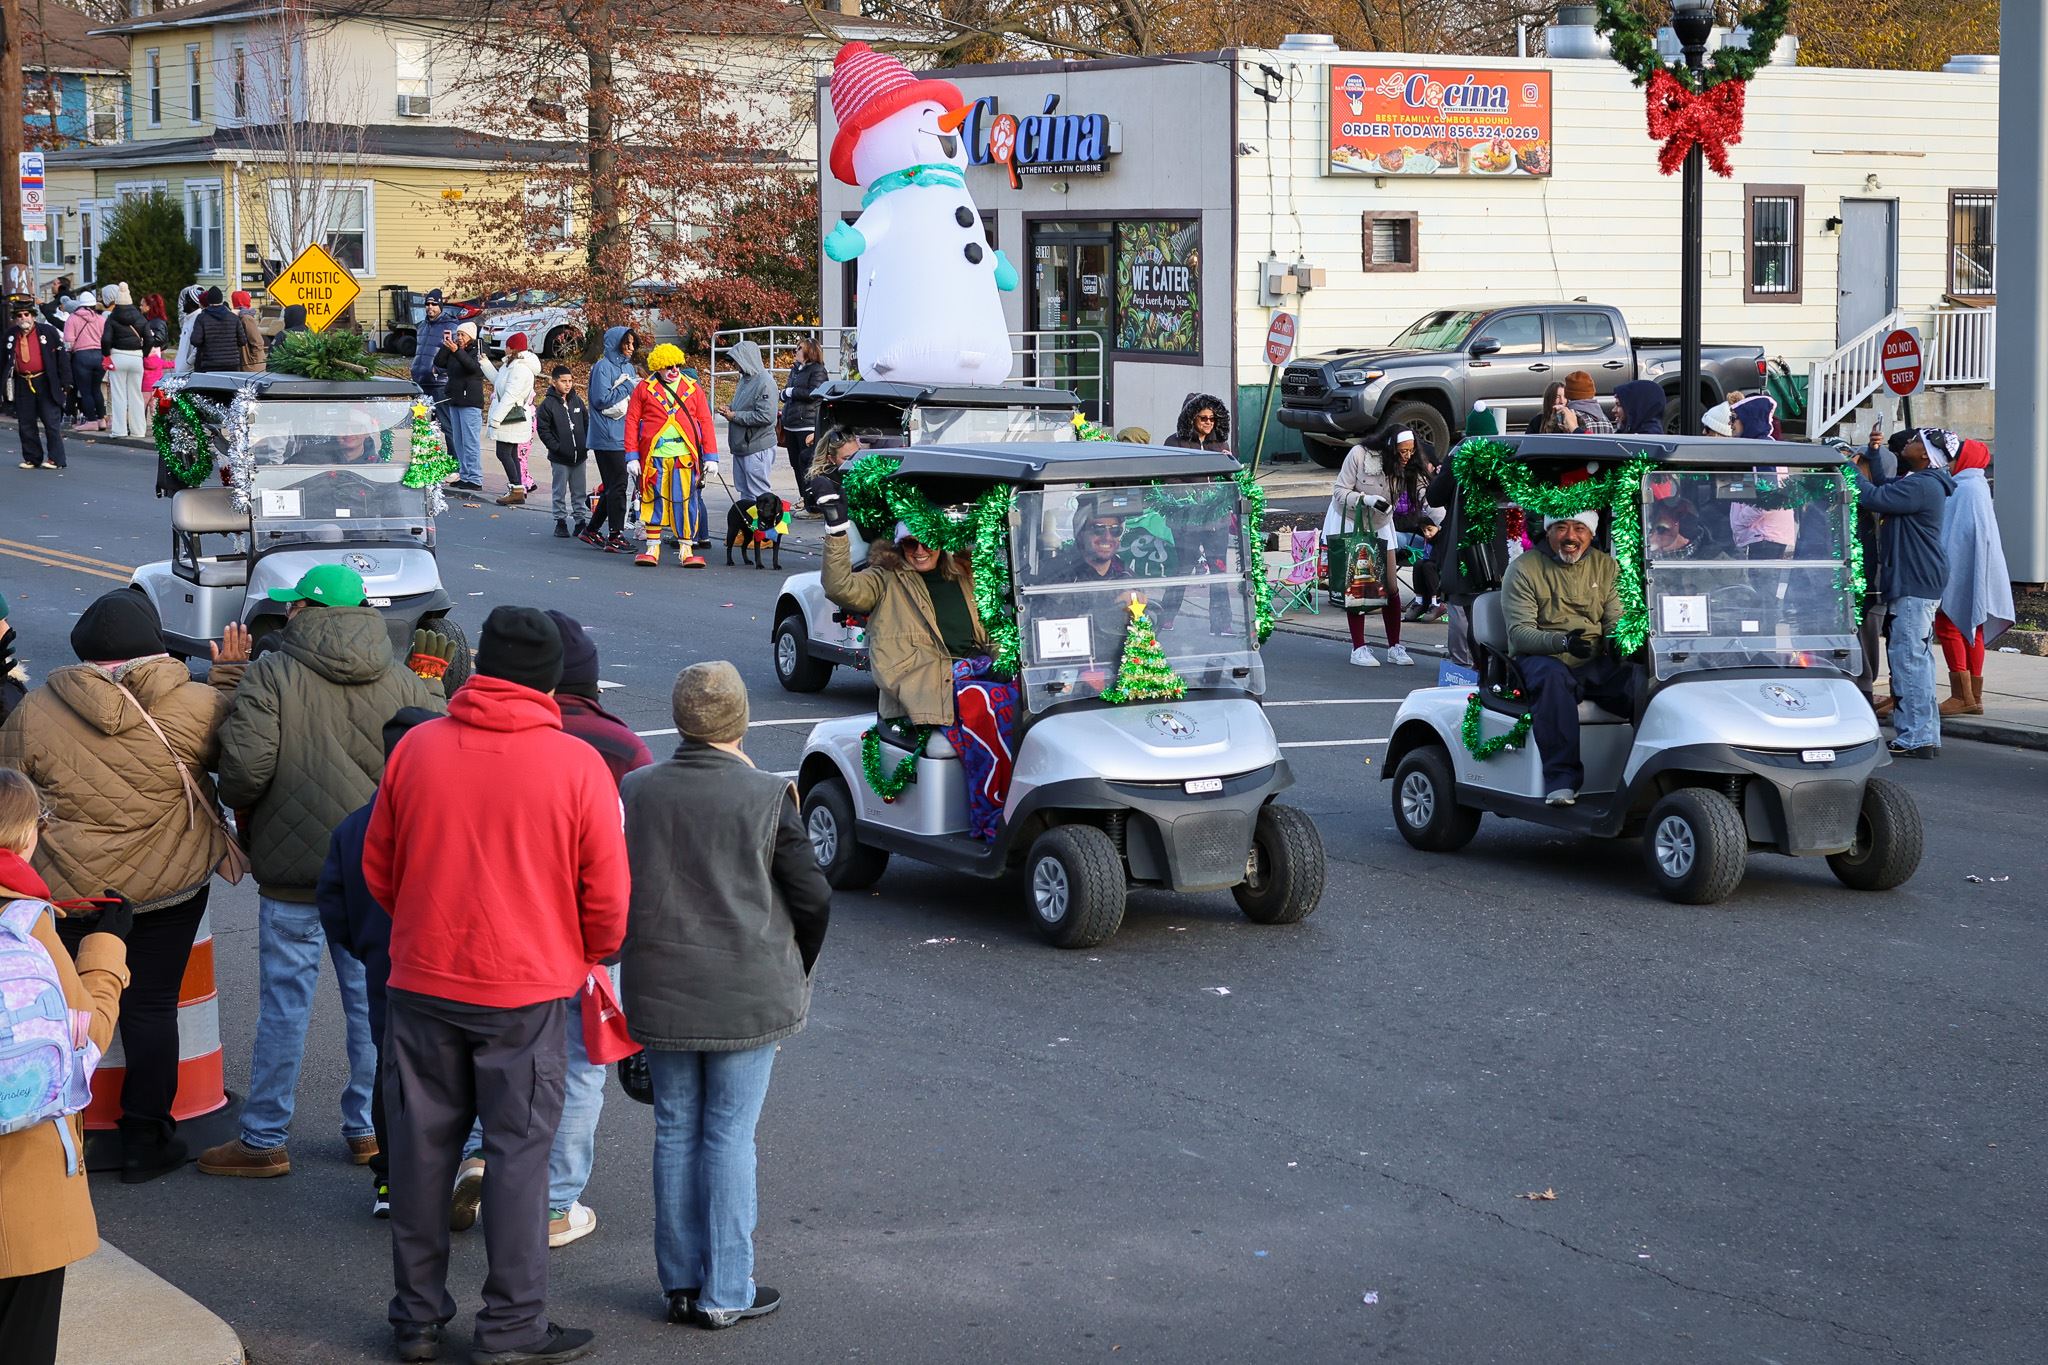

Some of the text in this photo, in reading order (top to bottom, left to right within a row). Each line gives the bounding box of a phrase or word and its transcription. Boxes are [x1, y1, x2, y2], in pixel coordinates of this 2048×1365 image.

[1376, 72, 1404, 98] La
[1342, 124, 1539, 139] ORDER TODAY! 856.324.0269
[1017, 164, 1102, 174] AUTHENTIC LATIN CUISINE
[290, 272, 340, 284] AUTISTIC
[1132, 266, 1190, 292] WE CATER
[298, 288, 332, 300] CHILD
[1133, 294, 1190, 310] Any Event, Any Size.
[1274, 322, 1292, 334] DO NOT
[1270, 344, 1286, 356] ENTER
[1887, 341, 1912, 354] DO NOT
[1892, 371, 1914, 384] ENTER
[1188, 780, 1220, 791] EZGO
